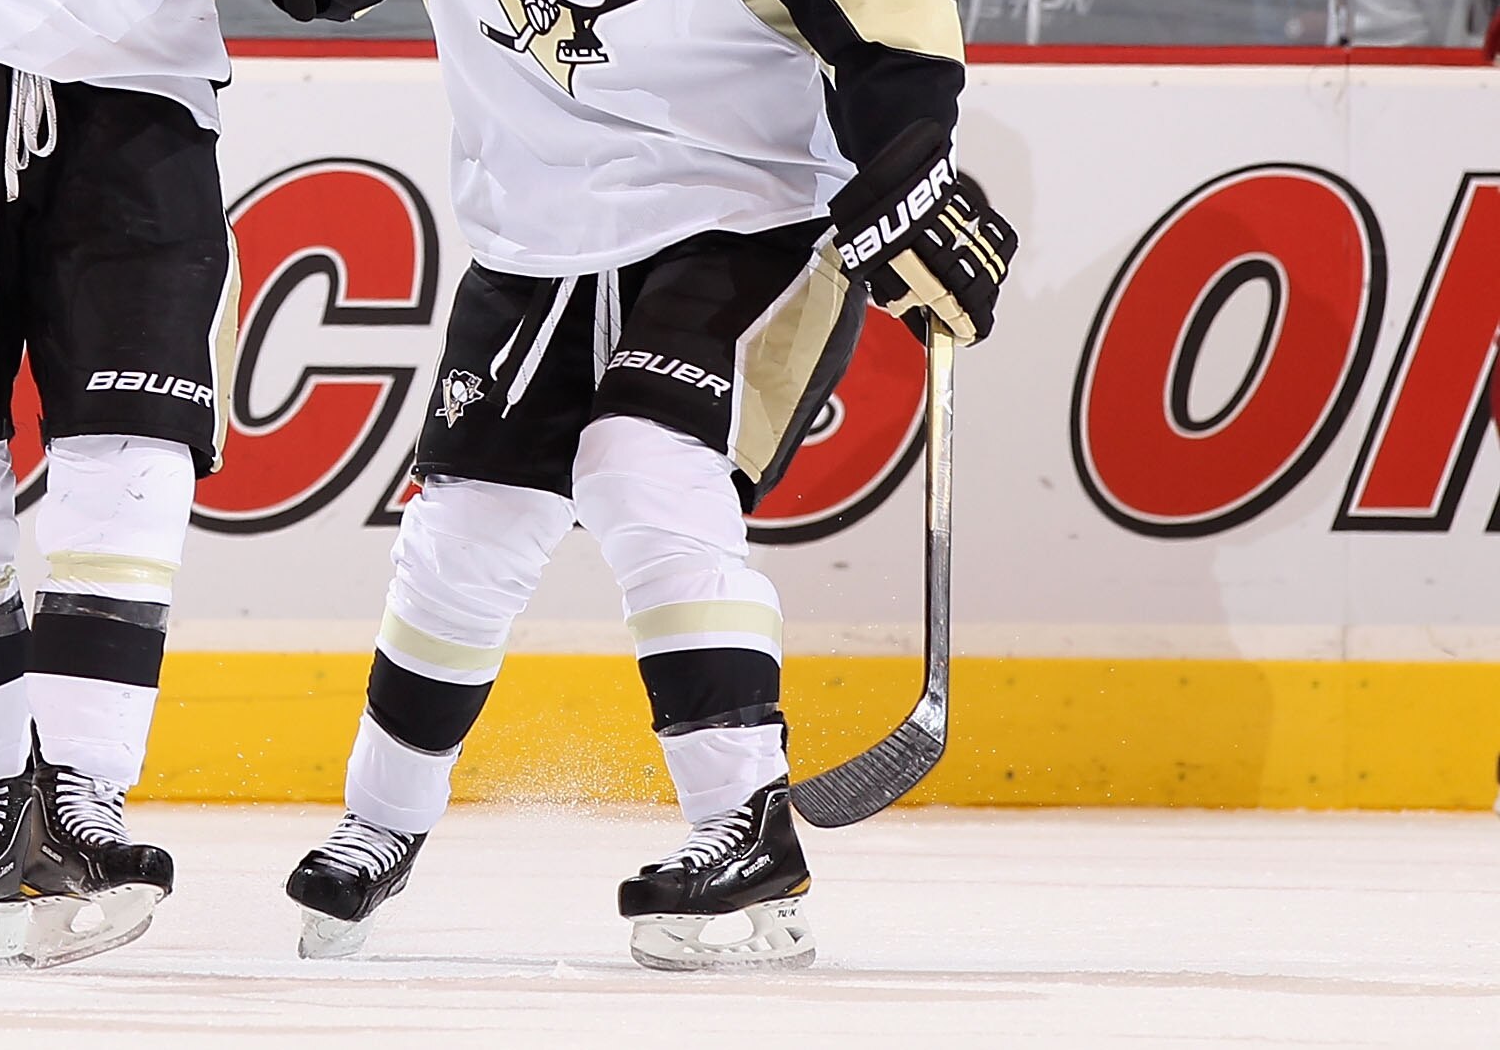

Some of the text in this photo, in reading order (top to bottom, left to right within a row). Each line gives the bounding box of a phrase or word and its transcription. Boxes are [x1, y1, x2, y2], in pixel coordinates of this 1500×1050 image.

[838, 158, 953, 269] BAUER
[85, 371, 213, 408] BAUER
[606, 350, 731, 398] BAUER
